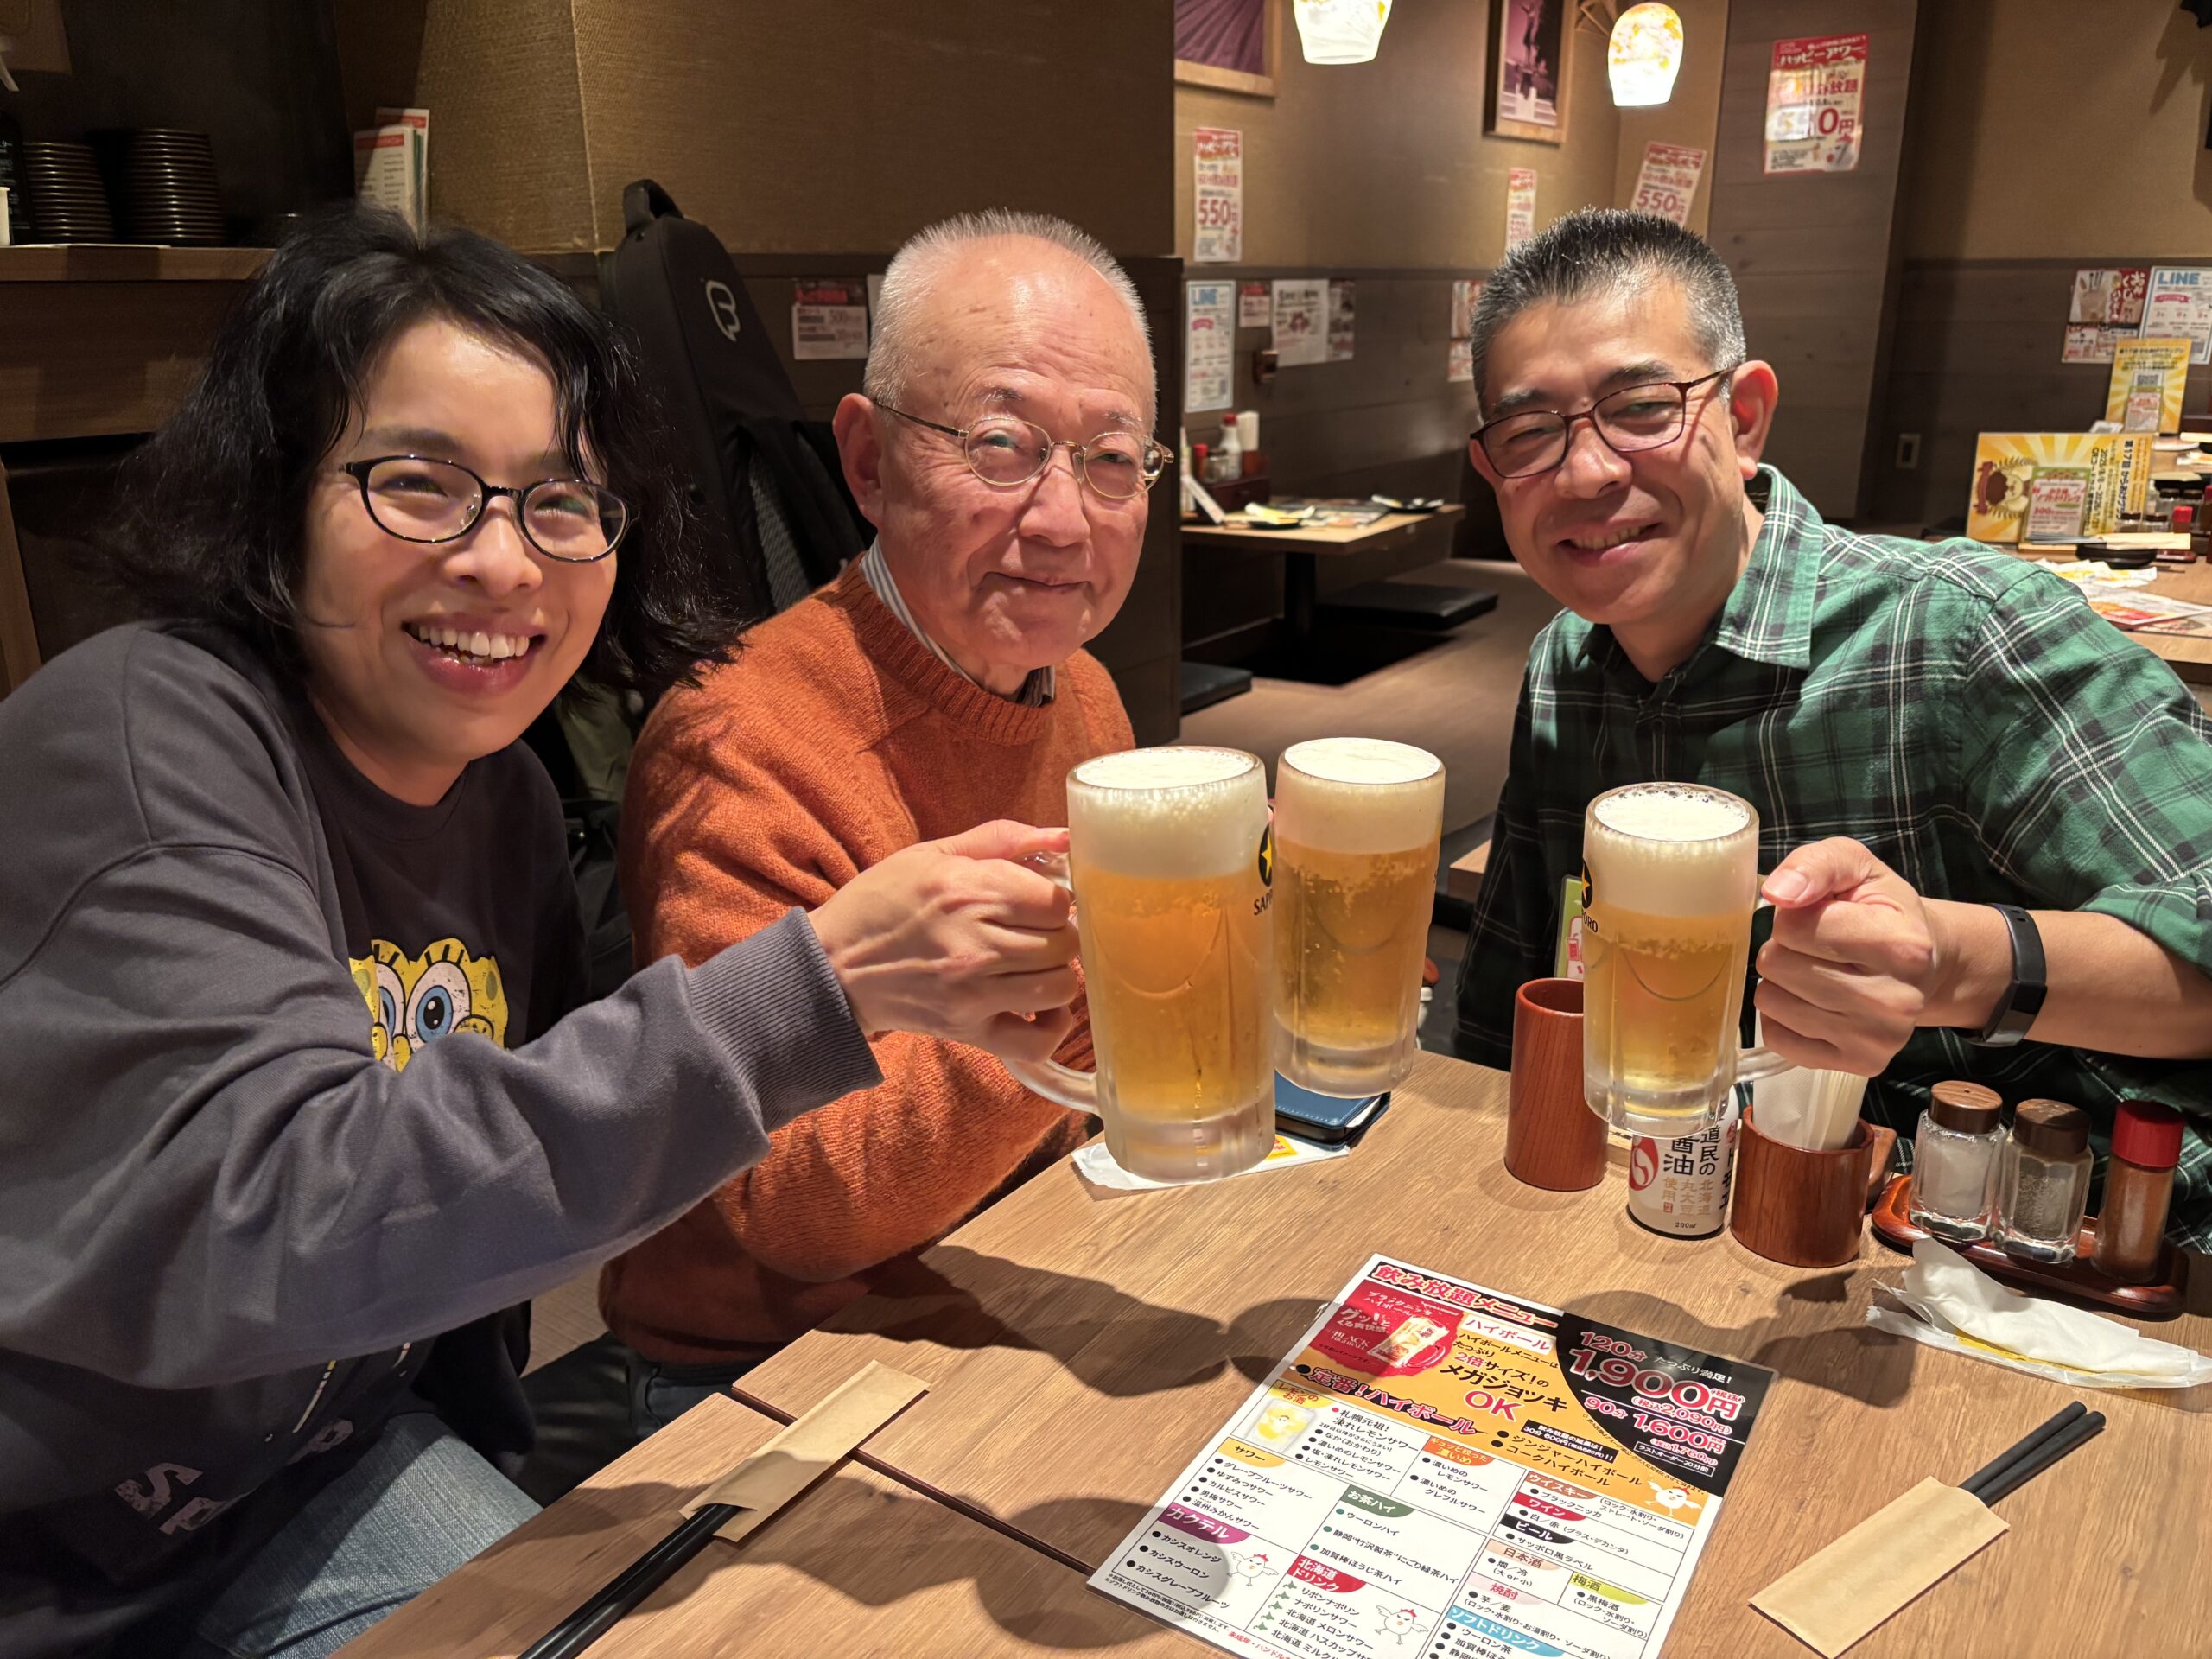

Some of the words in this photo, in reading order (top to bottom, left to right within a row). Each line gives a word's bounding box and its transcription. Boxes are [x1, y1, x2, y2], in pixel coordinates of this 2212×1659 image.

[2158, 271, 2201, 286] LINE
[1697, 1124, 1721, 1176] 道民の
[1372, 1265, 1558, 1328] 飲み放題メニュー
[1452, 1339, 1496, 1358] たっぷり
[1464, 1317, 1552, 1351] ハイボール
[1580, 1332, 1648, 1363] 120分
[1458, 1332, 1560, 1369] ハイボールメニューは
[1452, 1350, 1552, 1390] 2倍サイズ!の
[1568, 1348, 1743, 1421] 1,900円
[1306, 1365, 1481, 1437] 定番!ハイボール
[1438, 1359, 1571, 1415] メガジョッキ
[1461, 1387, 1523, 1421] OK
[1583, 1396, 1627, 1420] 90分
[1331, 1415, 1420, 1453] 凍れレモンサワー
[1632, 1412, 1726, 1455] 1,600円
[1231, 1445, 1267, 1463] サワー
[1304, 1456, 1354, 1479] レモンサワー
[1317, 1440, 1402, 1475] 濃いめのレモンサワー
[1431, 1459, 1469, 1478] 濃いめの
[1435, 1446, 1472, 1466] 濃いめ
[1505, 1444, 1611, 1487] コークハイボール
[1510, 1434, 1644, 1487] ジンジャーハイボール
[1206, 1479, 1266, 1507] カルピスサワー
[1215, 1470, 1274, 1497] ゆずみつサワー
[1222, 1460, 1313, 1501] グレープフルーツサワー
[1419, 1477, 1458, 1497] 濃いめの
[1436, 1469, 1489, 1494] レモンサワー
[1527, 1472, 1590, 1501] ウイスキー
[1190, 1498, 1261, 1531] 温州みかんサワー
[1198, 1489, 1243, 1511] 男梅サワー
[1346, 1489, 1395, 1514] お茶ハイ
[1423, 1487, 1486, 1516] グレフルサワー
[1526, 1497, 1566, 1519] ワイン
[1540, 1491, 1603, 1518] ブラックニッカ
[1166, 1504, 1233, 1541] カクテル
[1344, 1511, 1400, 1537] ウーロンハイ
[1514, 1519, 1554, 1542] ビール
[1147, 1548, 1210, 1581] カシスウーロン
[1160, 1534, 1222, 1565] カシスオレンジ
[1503, 1545, 1544, 1569] 日本酒
[1516, 1535, 1594, 1573] サッポロ黒ラベル
[1291, 1567, 1340, 1593] ドリンク
[1296, 1557, 1338, 1580] 北海道
[1319, 1547, 1402, 1586] 加賀棒ほうじ茶ハイ
[1135, 1563, 1230, 1611] カシスグレープフルーツ
[1488, 1581, 1520, 1602] 焼酎
[1571, 1573, 1602, 1592] 梅酒
[1292, 1597, 1358, 1630] ナポリンサワー
[1299, 1586, 1360, 1618] リボンナポリン
[1586, 1592, 1620, 1612] 黒梅酒
[1448, 1607, 1541, 1652] ソフトドリンク
[1459, 1626, 1513, 1656] ウーロン茶
